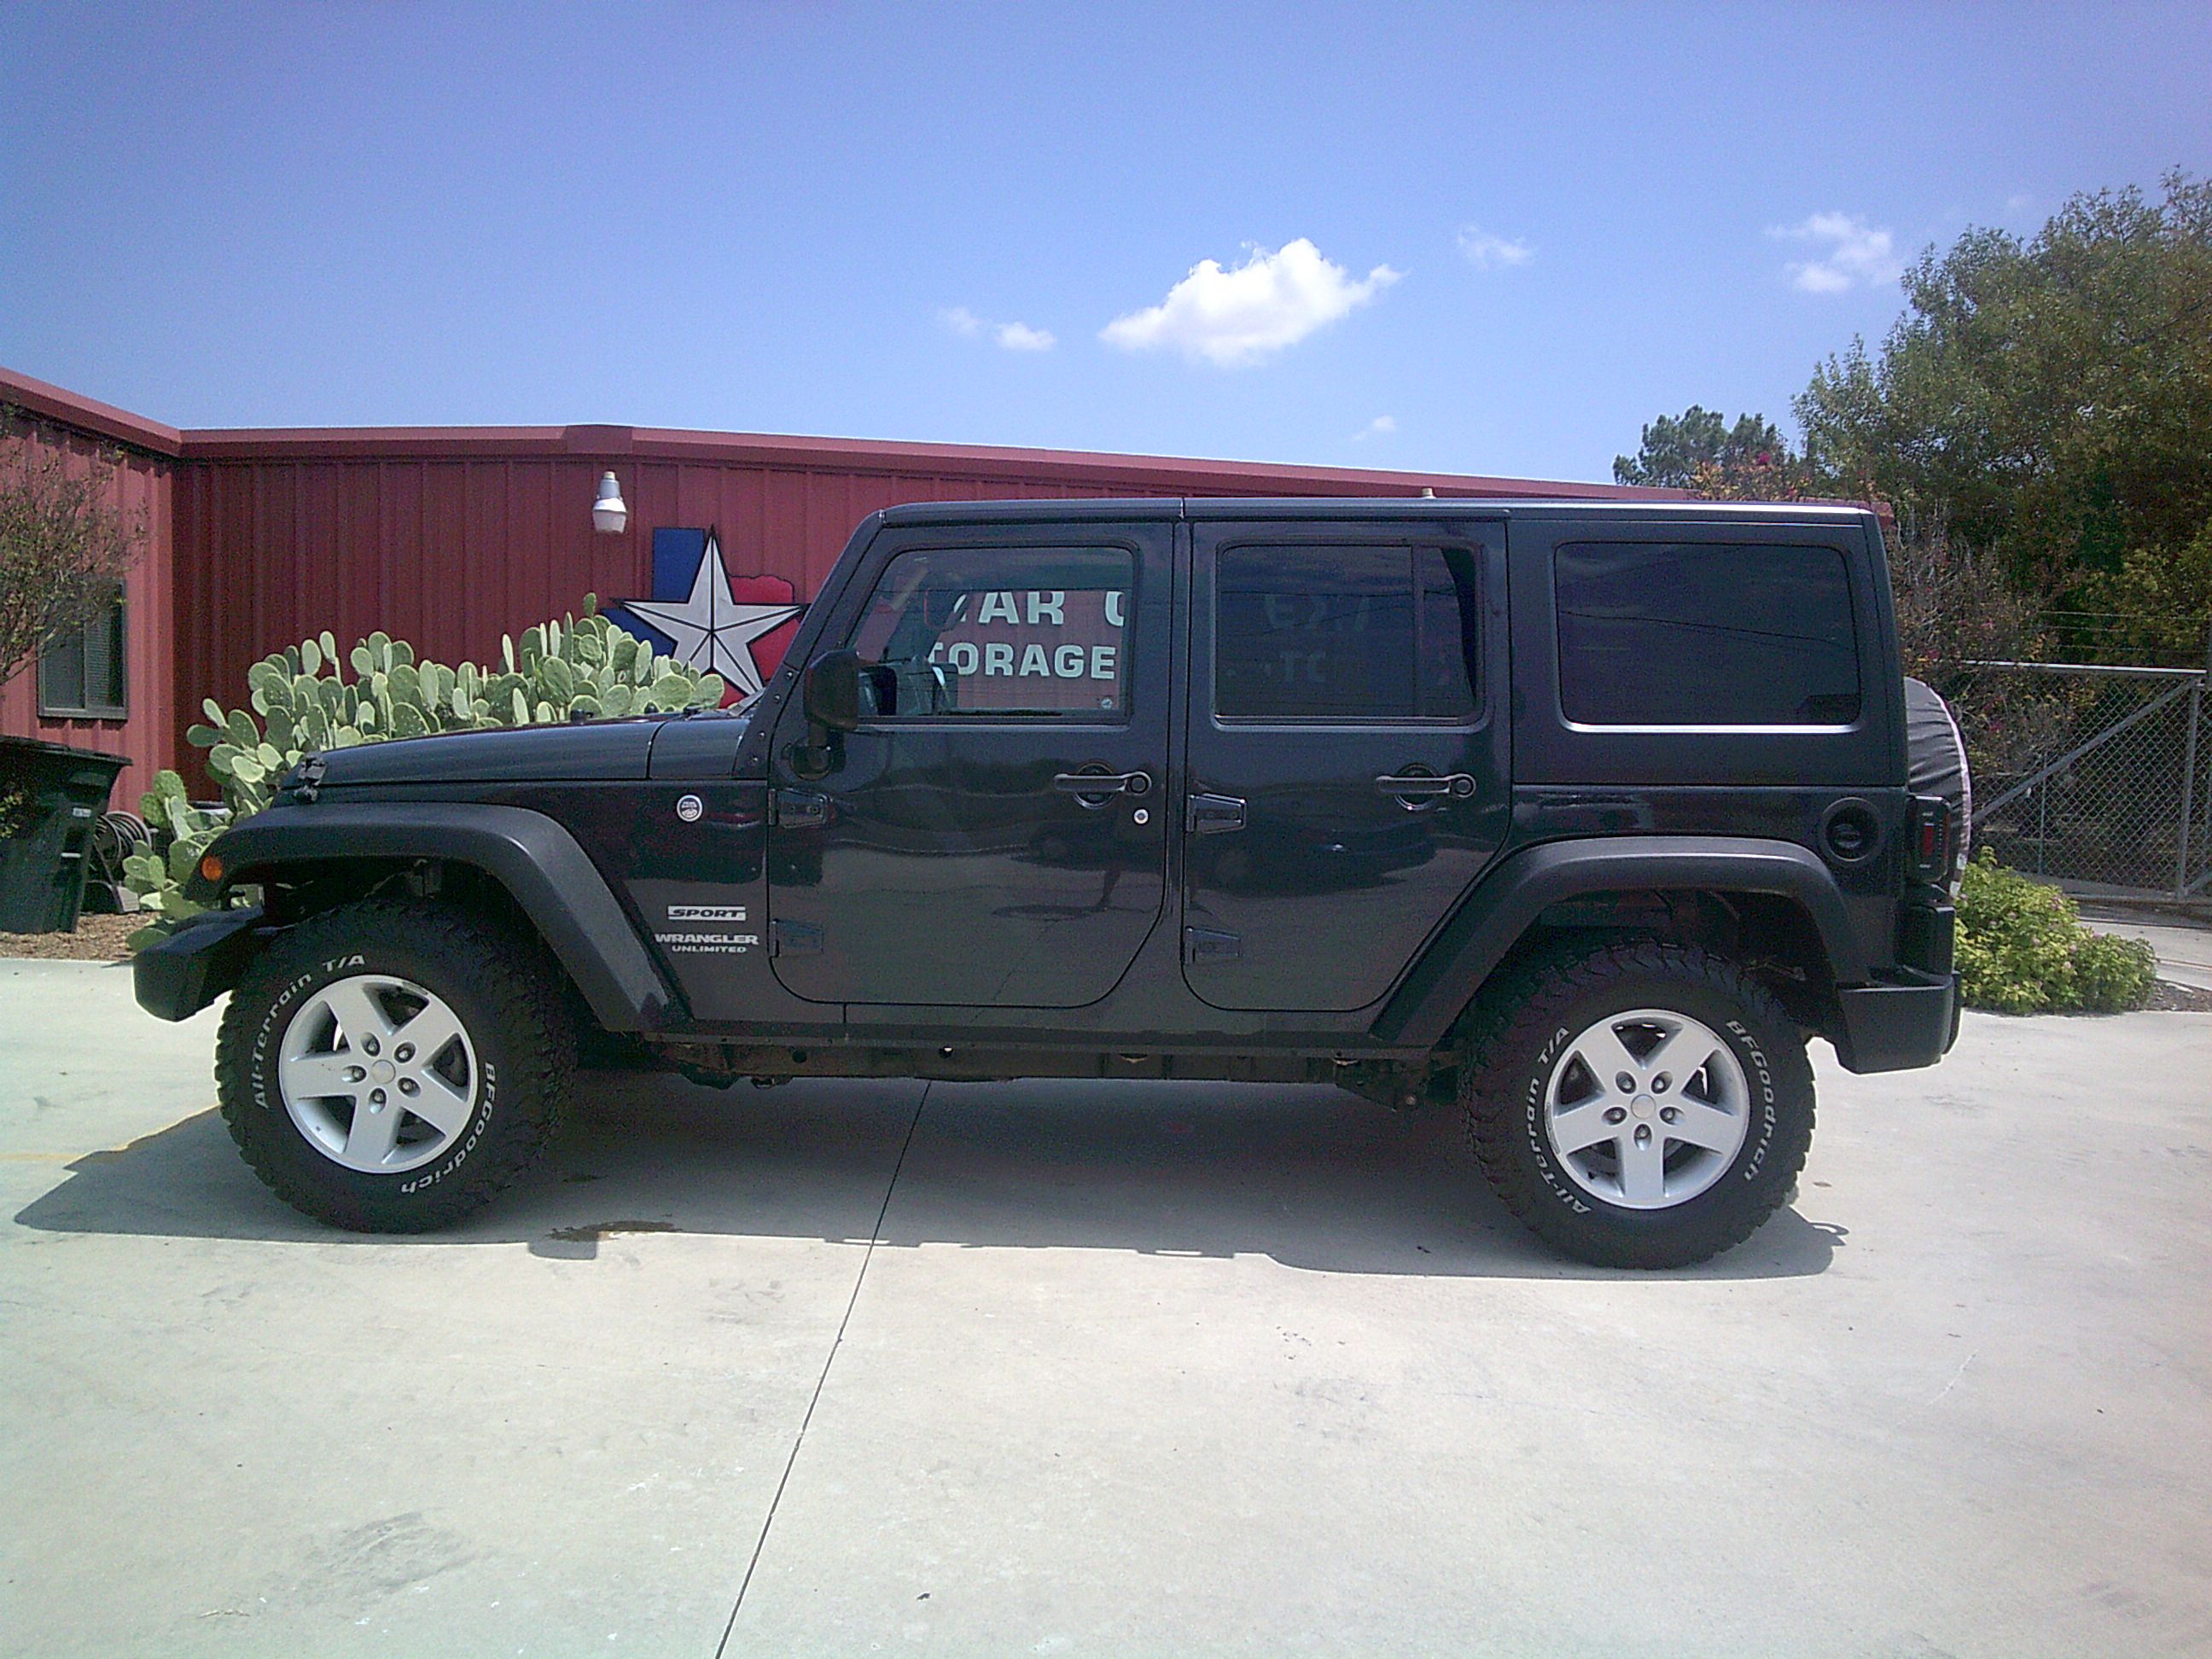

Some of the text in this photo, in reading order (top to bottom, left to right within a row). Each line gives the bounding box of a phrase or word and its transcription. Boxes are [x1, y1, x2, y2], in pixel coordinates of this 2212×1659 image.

[654, 933, 760, 945] WRANGLER
[671, 907, 747, 919] SPORT
[672, 945, 747, 953] UNLIMITED
[251, 954, 365, 1109] All-Terrain T/A
[401, 1062, 497, 1193] BFGoodrich
[1527, 1027, 1592, 1214] All-Terrain T/A
[1726, 1021, 1776, 1180] BFGoodrich
